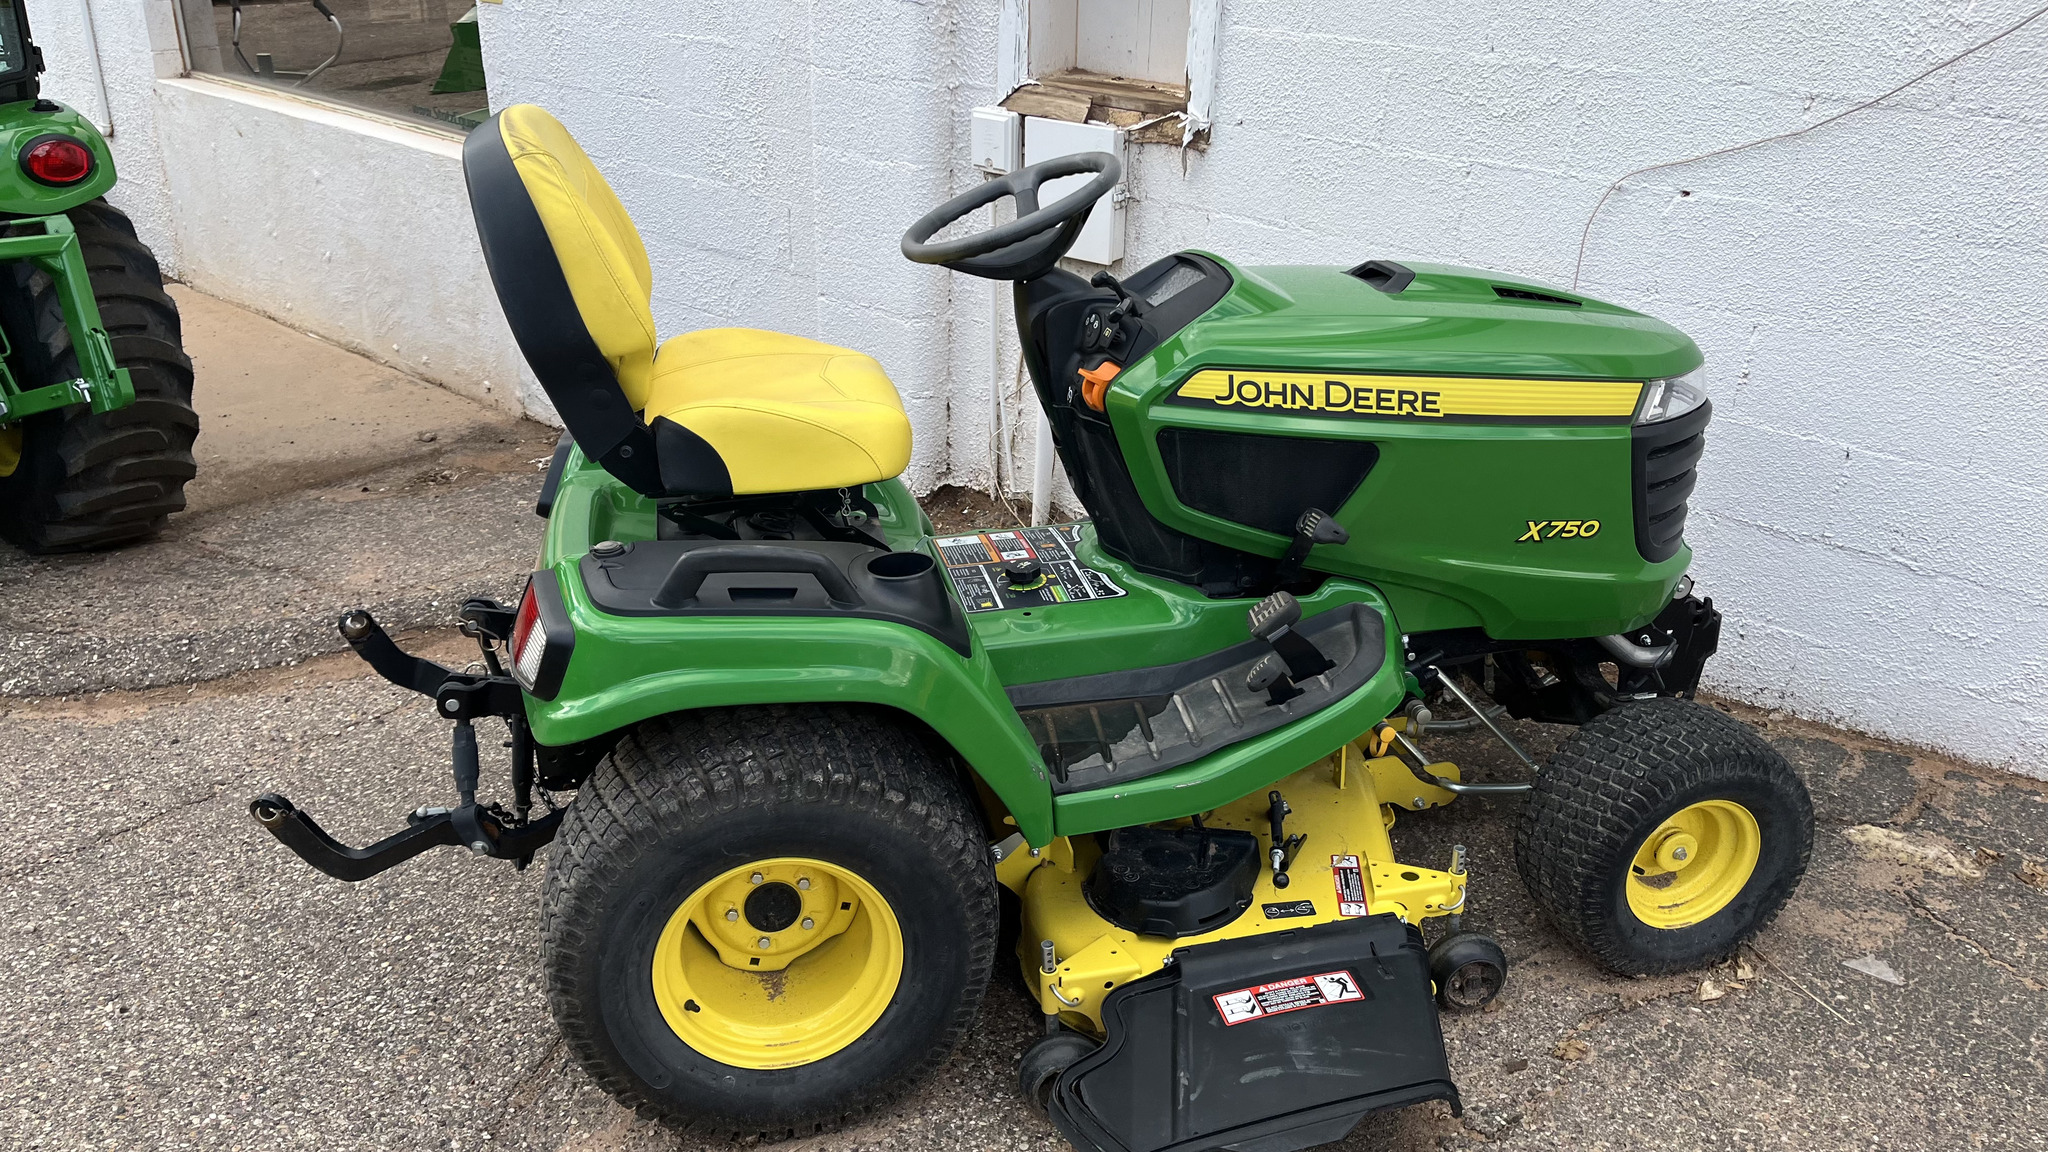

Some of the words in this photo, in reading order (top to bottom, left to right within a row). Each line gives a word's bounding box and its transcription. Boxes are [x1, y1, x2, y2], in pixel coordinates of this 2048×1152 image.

[1215, 374, 1315, 408] JOHN
[1325, 380, 1442, 415] DEERE
[1515, 519, 1601, 542] X750
[1267, 978, 1307, 990] DANGER
